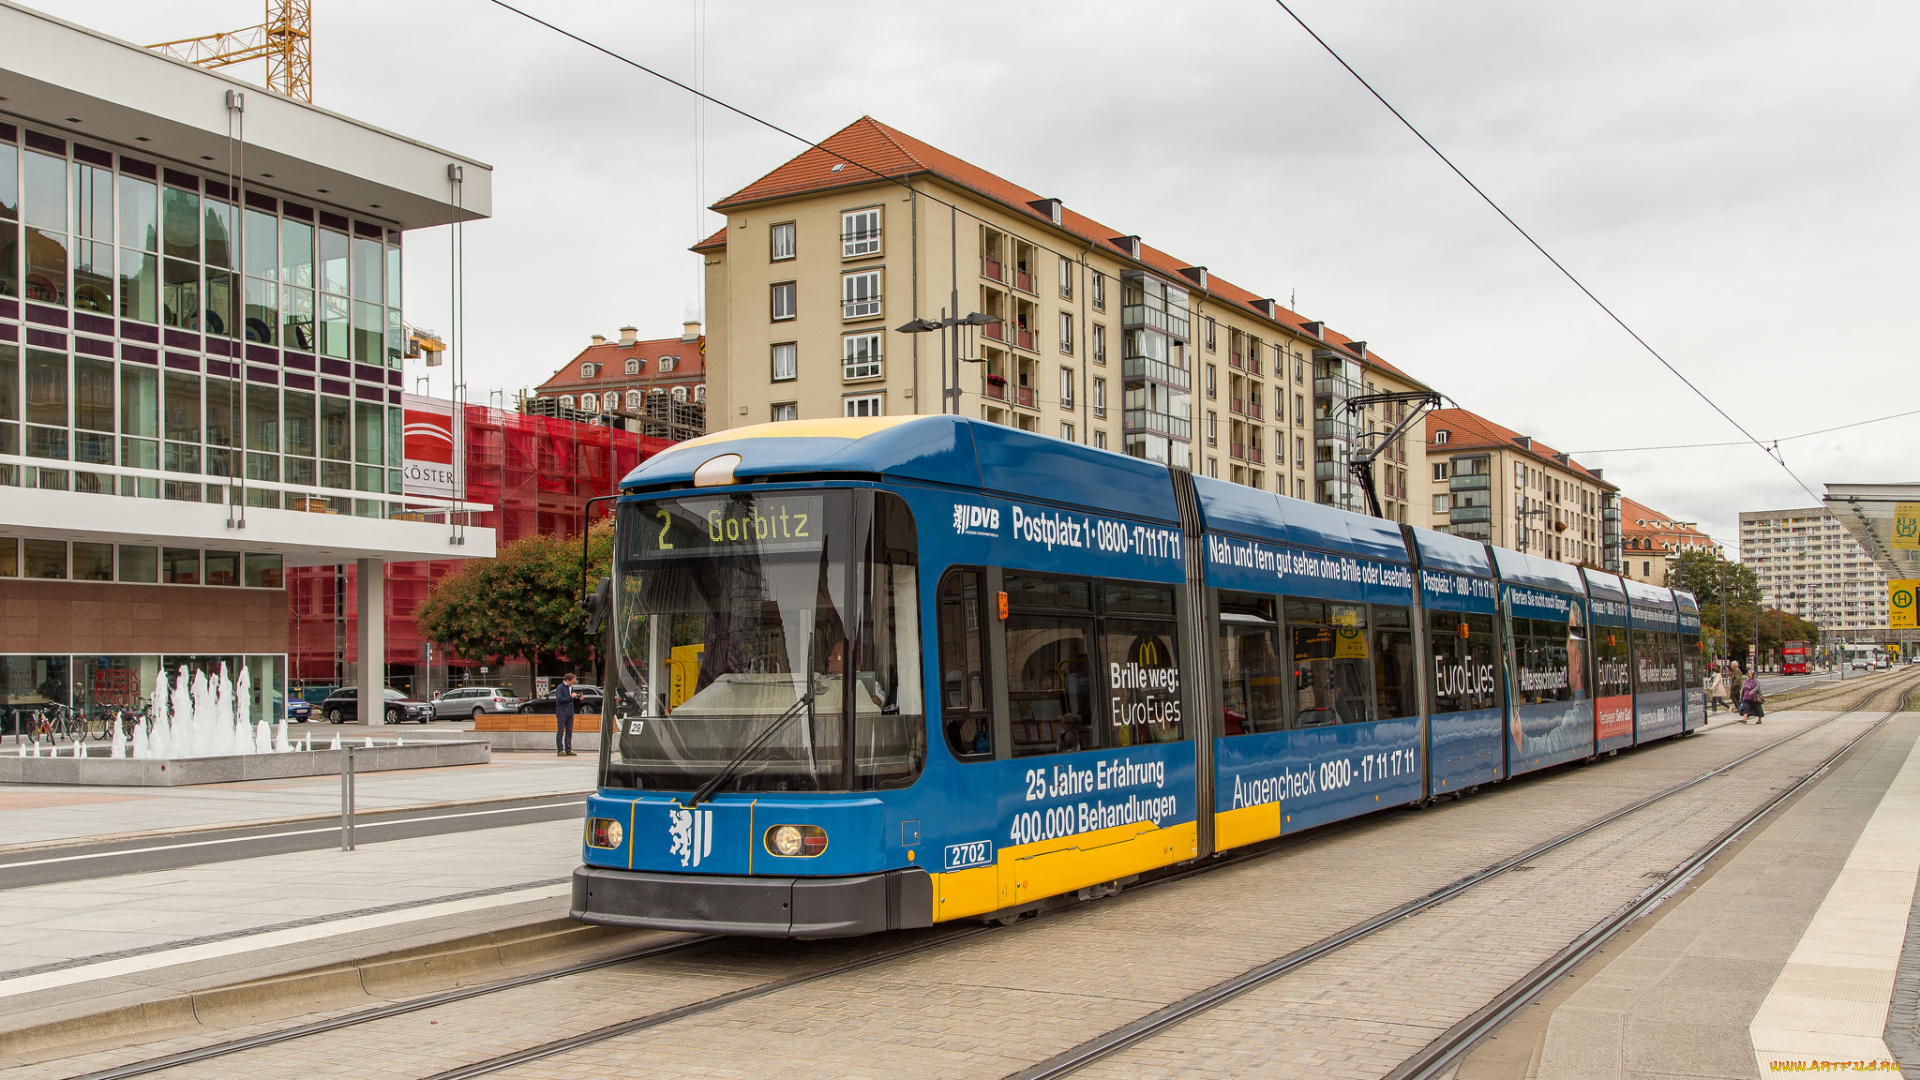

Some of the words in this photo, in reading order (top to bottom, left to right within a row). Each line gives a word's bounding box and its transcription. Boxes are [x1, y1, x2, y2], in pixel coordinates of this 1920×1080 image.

[656, 509, 674, 550] 2
[707, 504, 809, 542] Gorbitz
[970, 505, 1000, 530] DVB
[1012, 505, 1082, 551] Postplatz
[1208, 534, 1232, 565] Nah
[1233, 541, 1252, 568] und
[1254, 543, 1275, 571] fern
[1276, 549, 1292, 579] gut
[1293, 551, 1319, 578] sehen
[1320, 554, 1340, 580] ohne
[1340, 557, 1361, 583] Brille
[1362, 560, 1379, 584] oder
[1379, 563, 1412, 589] Lesebrille
[1422, 570, 1449, 597] Postplatz
[1456, 576, 1469, 596] 0800
[1511, 587, 1528, 606] Warten
[1527, 590, 1535, 607] Sie
[1534, 592, 1546, 608] nicht
[1545, 594, 1555, 609] noch
[94, 668, 138, 681] WERK
[94, 681, 139, 694] BUND
[1110, 662, 1147, 689] Brille
[1148, 667, 1180, 694] weg:
[1435, 655, 1495, 703] EuroEyes
[94, 693, 139, 706] STADT
[1112, 695, 1181, 730] EuroEyes
[1026, 768, 1046, 801] 25
[1049, 765, 1093, 798] Jahre
[1097, 757, 1165, 791] Erfahrung
[1232, 762, 1316, 810] Augencheck
[1320, 758, 1351, 792] 0800
[1361, 754, 1374, 783] 17
[1376, 752, 1388, 780] 11
[1391, 749, 1402, 776] 17
[1404, 747, 1415, 774] 11
[1010, 805, 1075, 846] 400.000
[1078, 794, 1177, 834] Behandlungen
[951, 843, 985, 866] 2702
